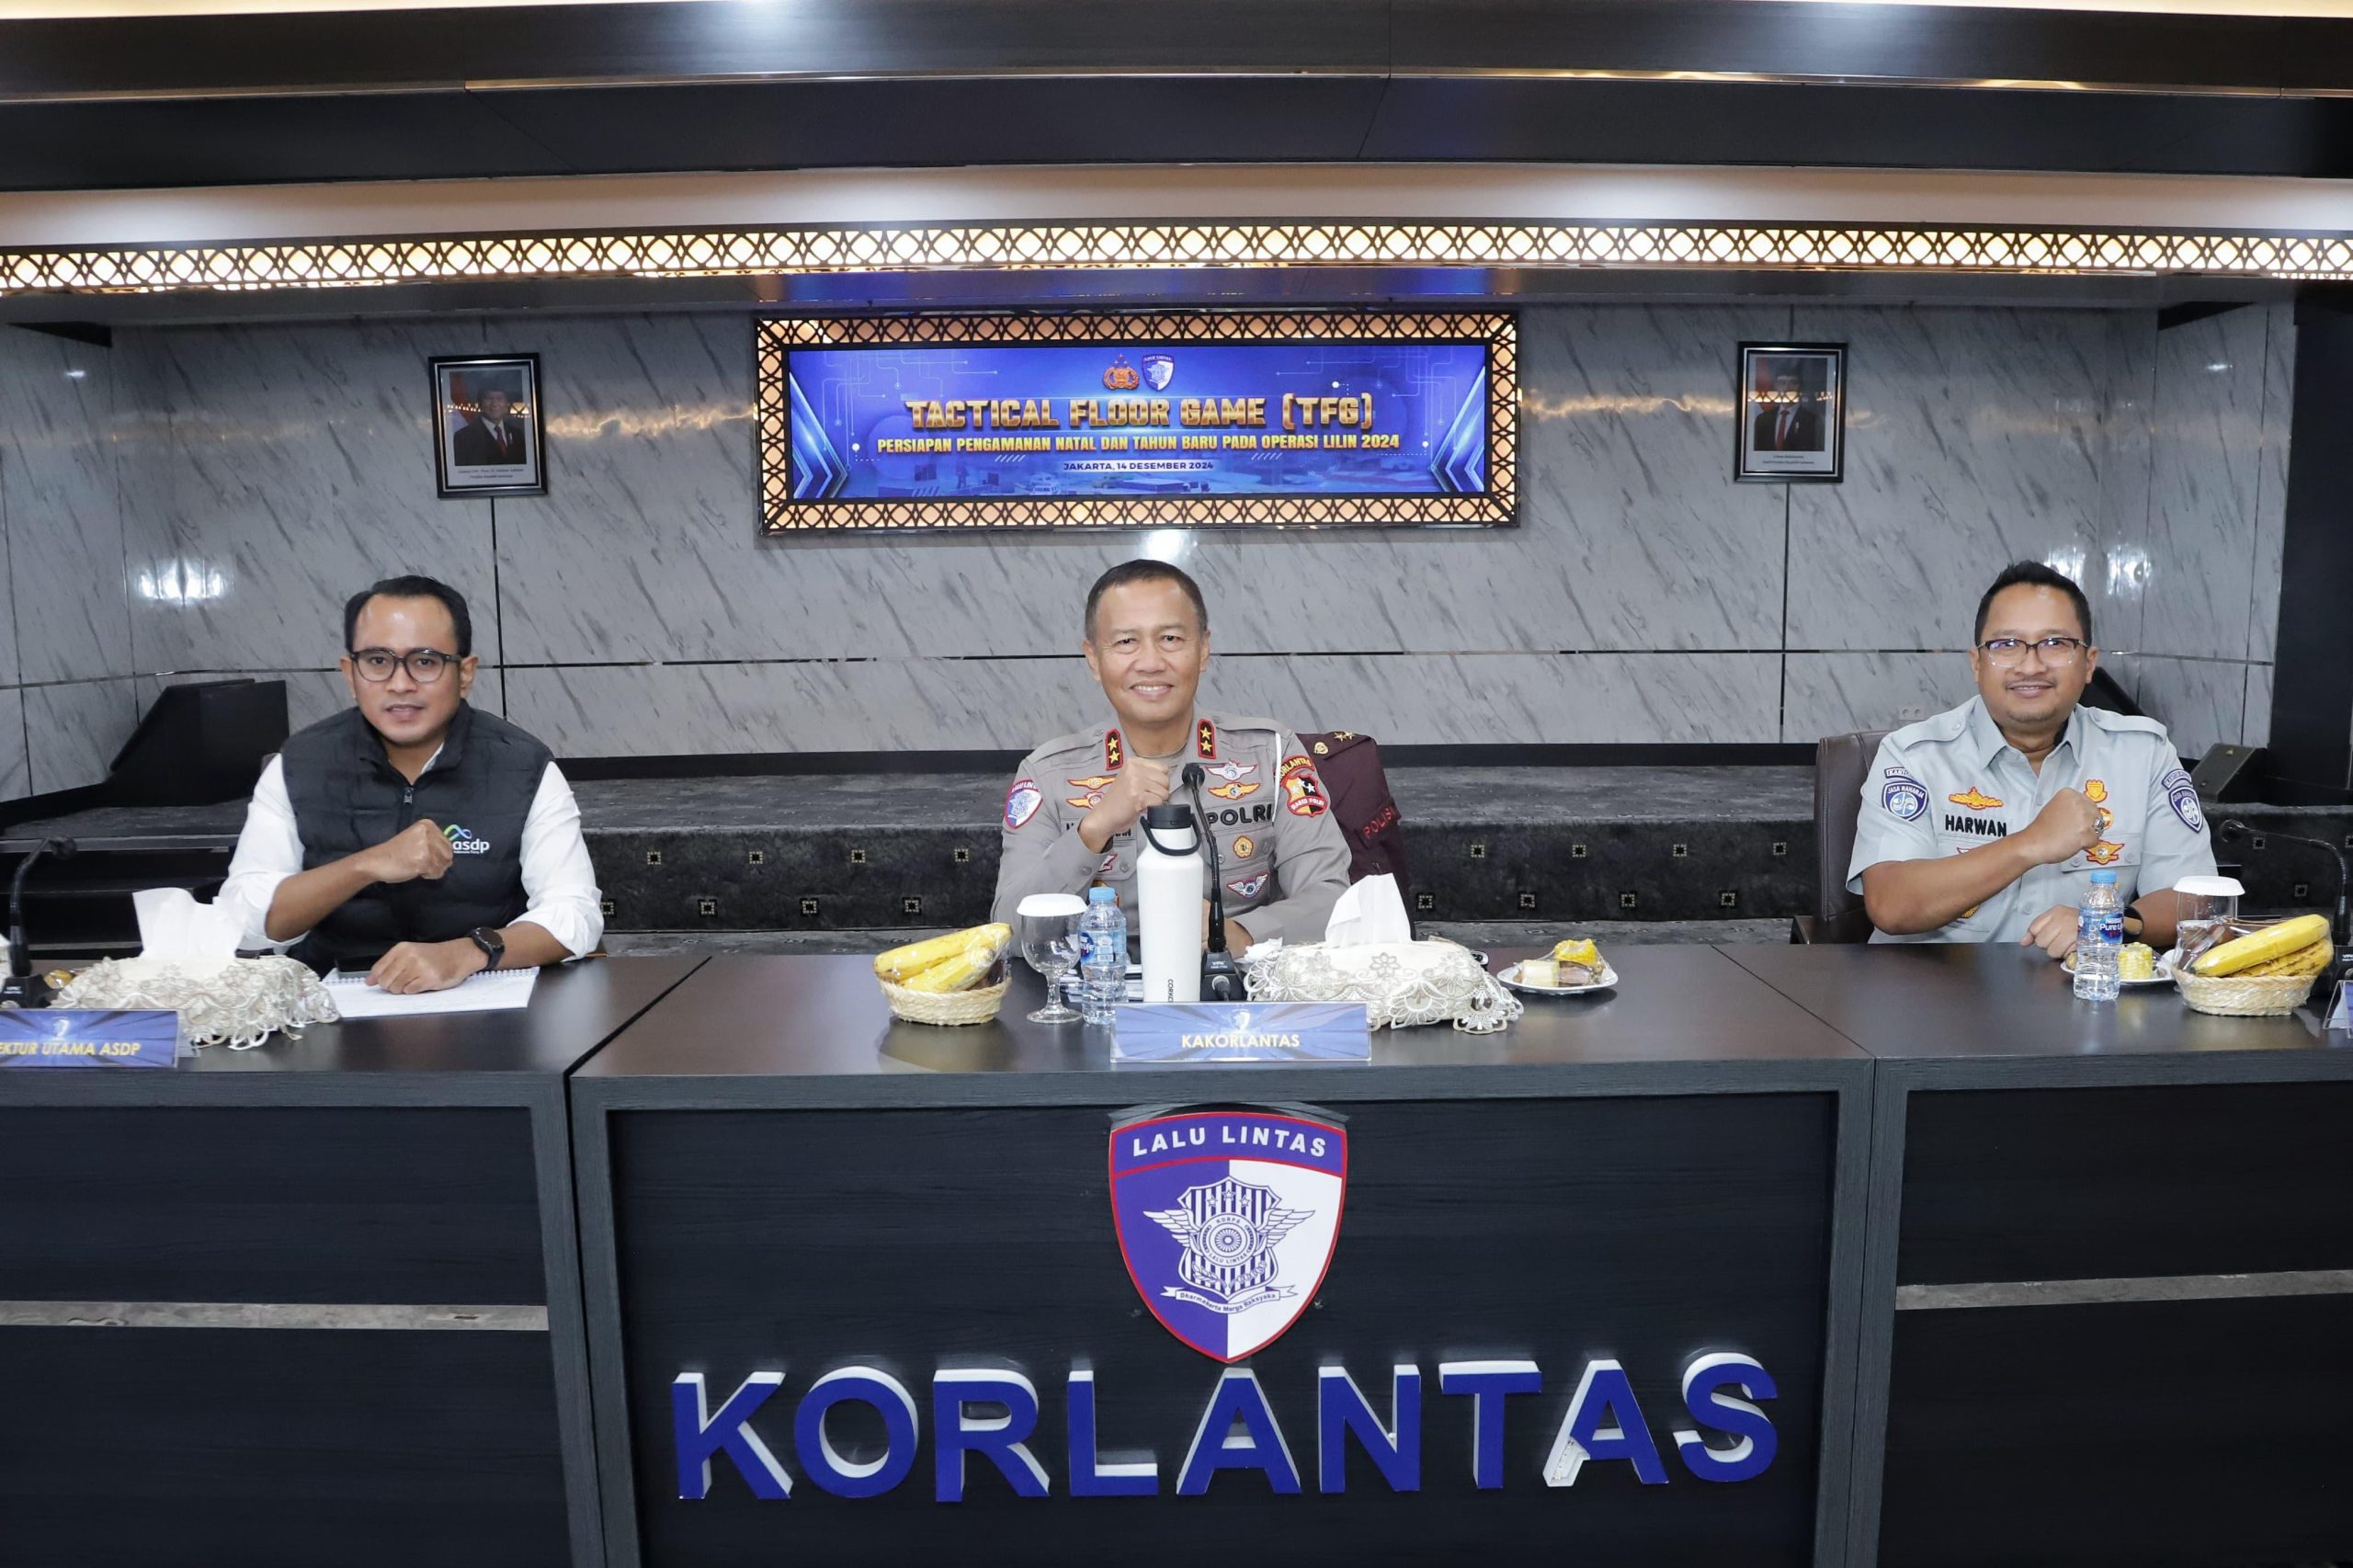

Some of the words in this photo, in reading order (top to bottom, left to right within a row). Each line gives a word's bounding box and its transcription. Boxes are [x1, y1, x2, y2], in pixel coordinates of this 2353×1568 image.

[905, 399, 1060, 428] TACTICAL
[1069, 398, 1171, 427] FLOOR
[1180, 397, 1267, 426] GAME
[877, 438, 952, 453] PERSIAPAN
[957, 437, 1051, 452] PENGAMANAN
[1055, 437, 1096, 451] NATAL
[1101, 437, 1128, 450] DAN
[1132, 436, 1176, 450] TAHUN
[1182, 435, 1217, 449] BARU
[1222, 435, 1256, 449] PADA
[1261, 435, 1318, 449] OPERASI
[1324, 434, 1357, 449] LILIN
[1361, 434, 1400, 449] 2024
[1063, 462, 1115, 472] JAKARTA,
[1117, 462, 1127, 471] 14
[1130, 461, 1187, 471] DESEMBER
[1188, 461, 1214, 471] 2024
[1206, 804, 1272, 825] POLRI
[1945, 814, 2007, 837] HARWAN
[452, 837, 491, 854] asdp
[41, 1042, 96, 1056] UTAMA
[98, 1043, 141, 1056] ASDP
[1181, 1034, 1301, 1049] KAKORLANTAS
[1133, 1127, 1206, 1157] LALU
[1222, 1126, 1326, 1157] LINTAS
[1209, 1252, 1224, 1263] LALU
[1225, 1253, 1248, 1264] LINTAS
[670, 1351, 1779, 1505] KORLANTAS
